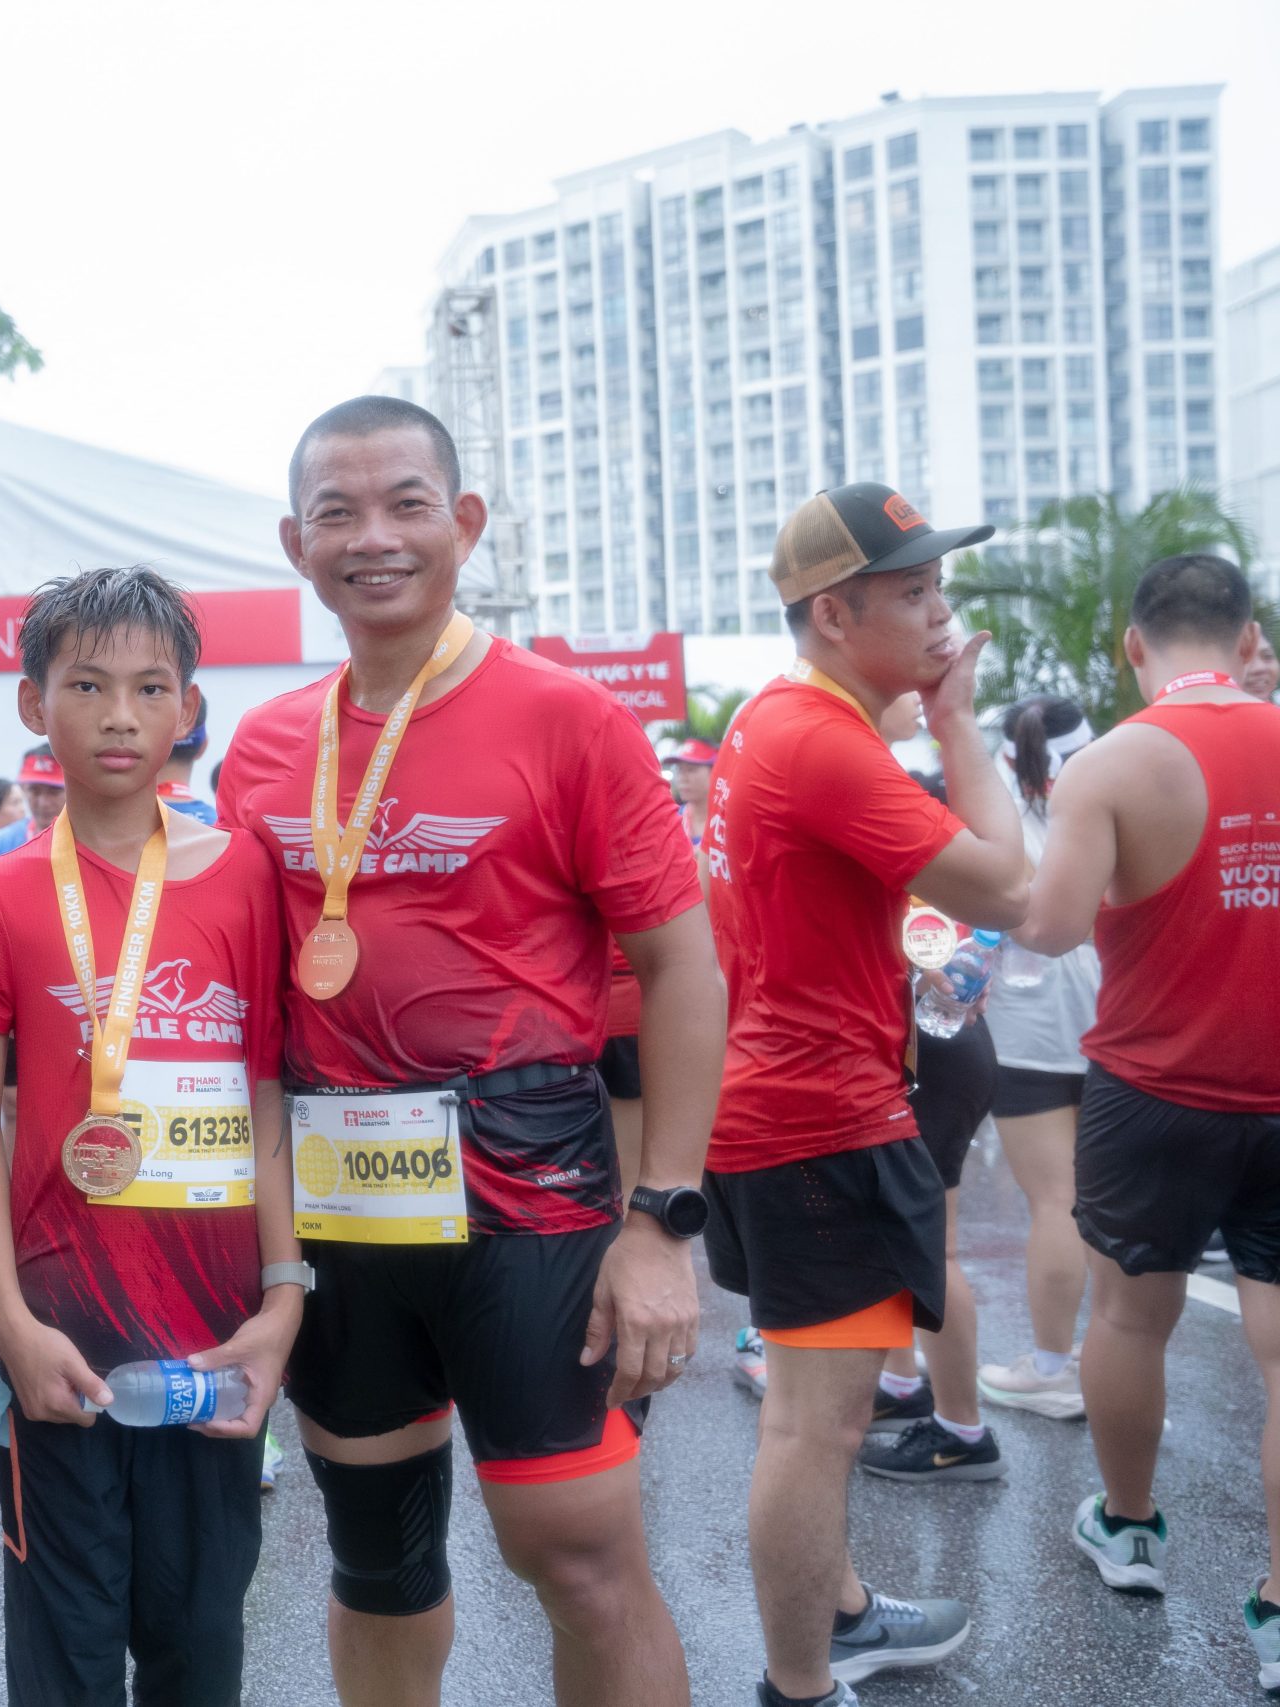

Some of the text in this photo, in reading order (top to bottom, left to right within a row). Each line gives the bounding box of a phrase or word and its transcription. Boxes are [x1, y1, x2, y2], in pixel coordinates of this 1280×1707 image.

[353, 692, 414, 830] FINISHER 10KM
[384, 853, 468, 874] CAMP
[62, 883, 85, 929] 10KM
[114, 933, 145, 1018] FINISHER
[134, 881, 156, 928] 10KM
[196, 1076, 221, 1085] HANOI
[359, 1110, 389, 1118] HANOI
[169, 1116, 250, 1146] 613236
[137, 1168, 248, 1179] ch Long MALE
[344, 1148, 452, 1180] 100406
[537, 1168, 580, 1186] LONG.VN
[301, 1222, 322, 1230] 10KM
